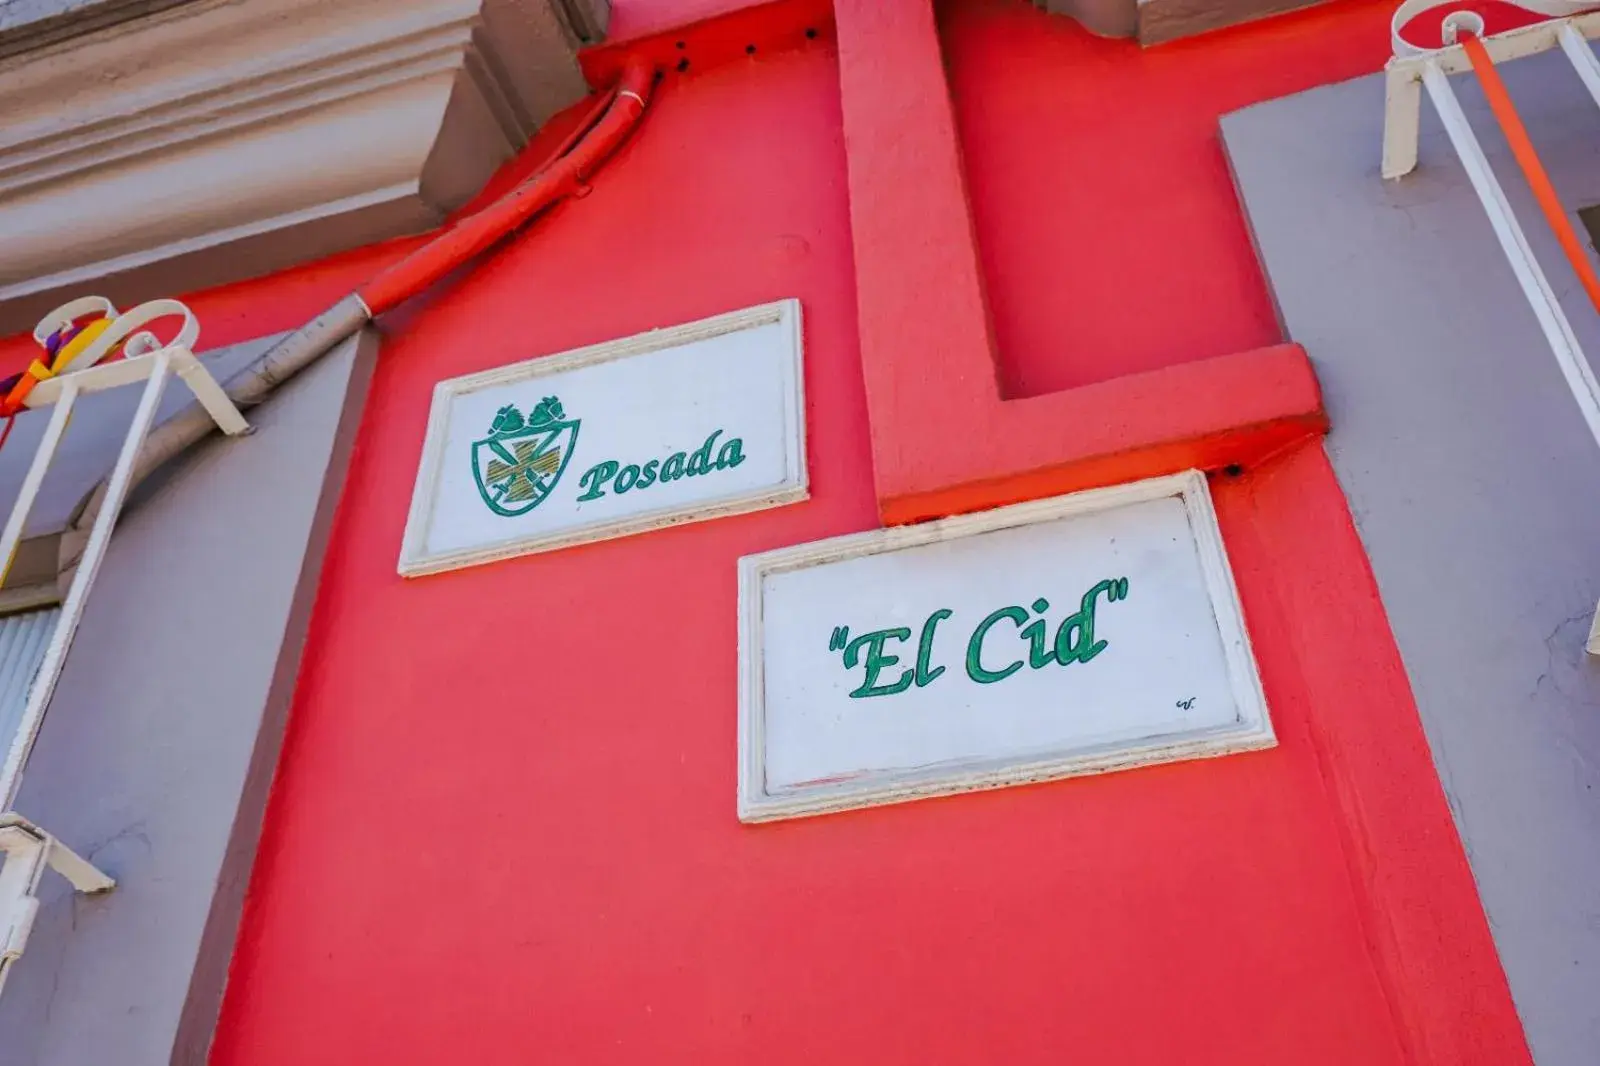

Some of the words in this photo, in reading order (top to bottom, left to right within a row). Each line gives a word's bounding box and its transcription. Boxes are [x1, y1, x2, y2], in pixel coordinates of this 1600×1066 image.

[576, 428, 746, 502] Posada
[829, 608, 953, 699] "El
[965, 577, 1129, 684] Cid"
